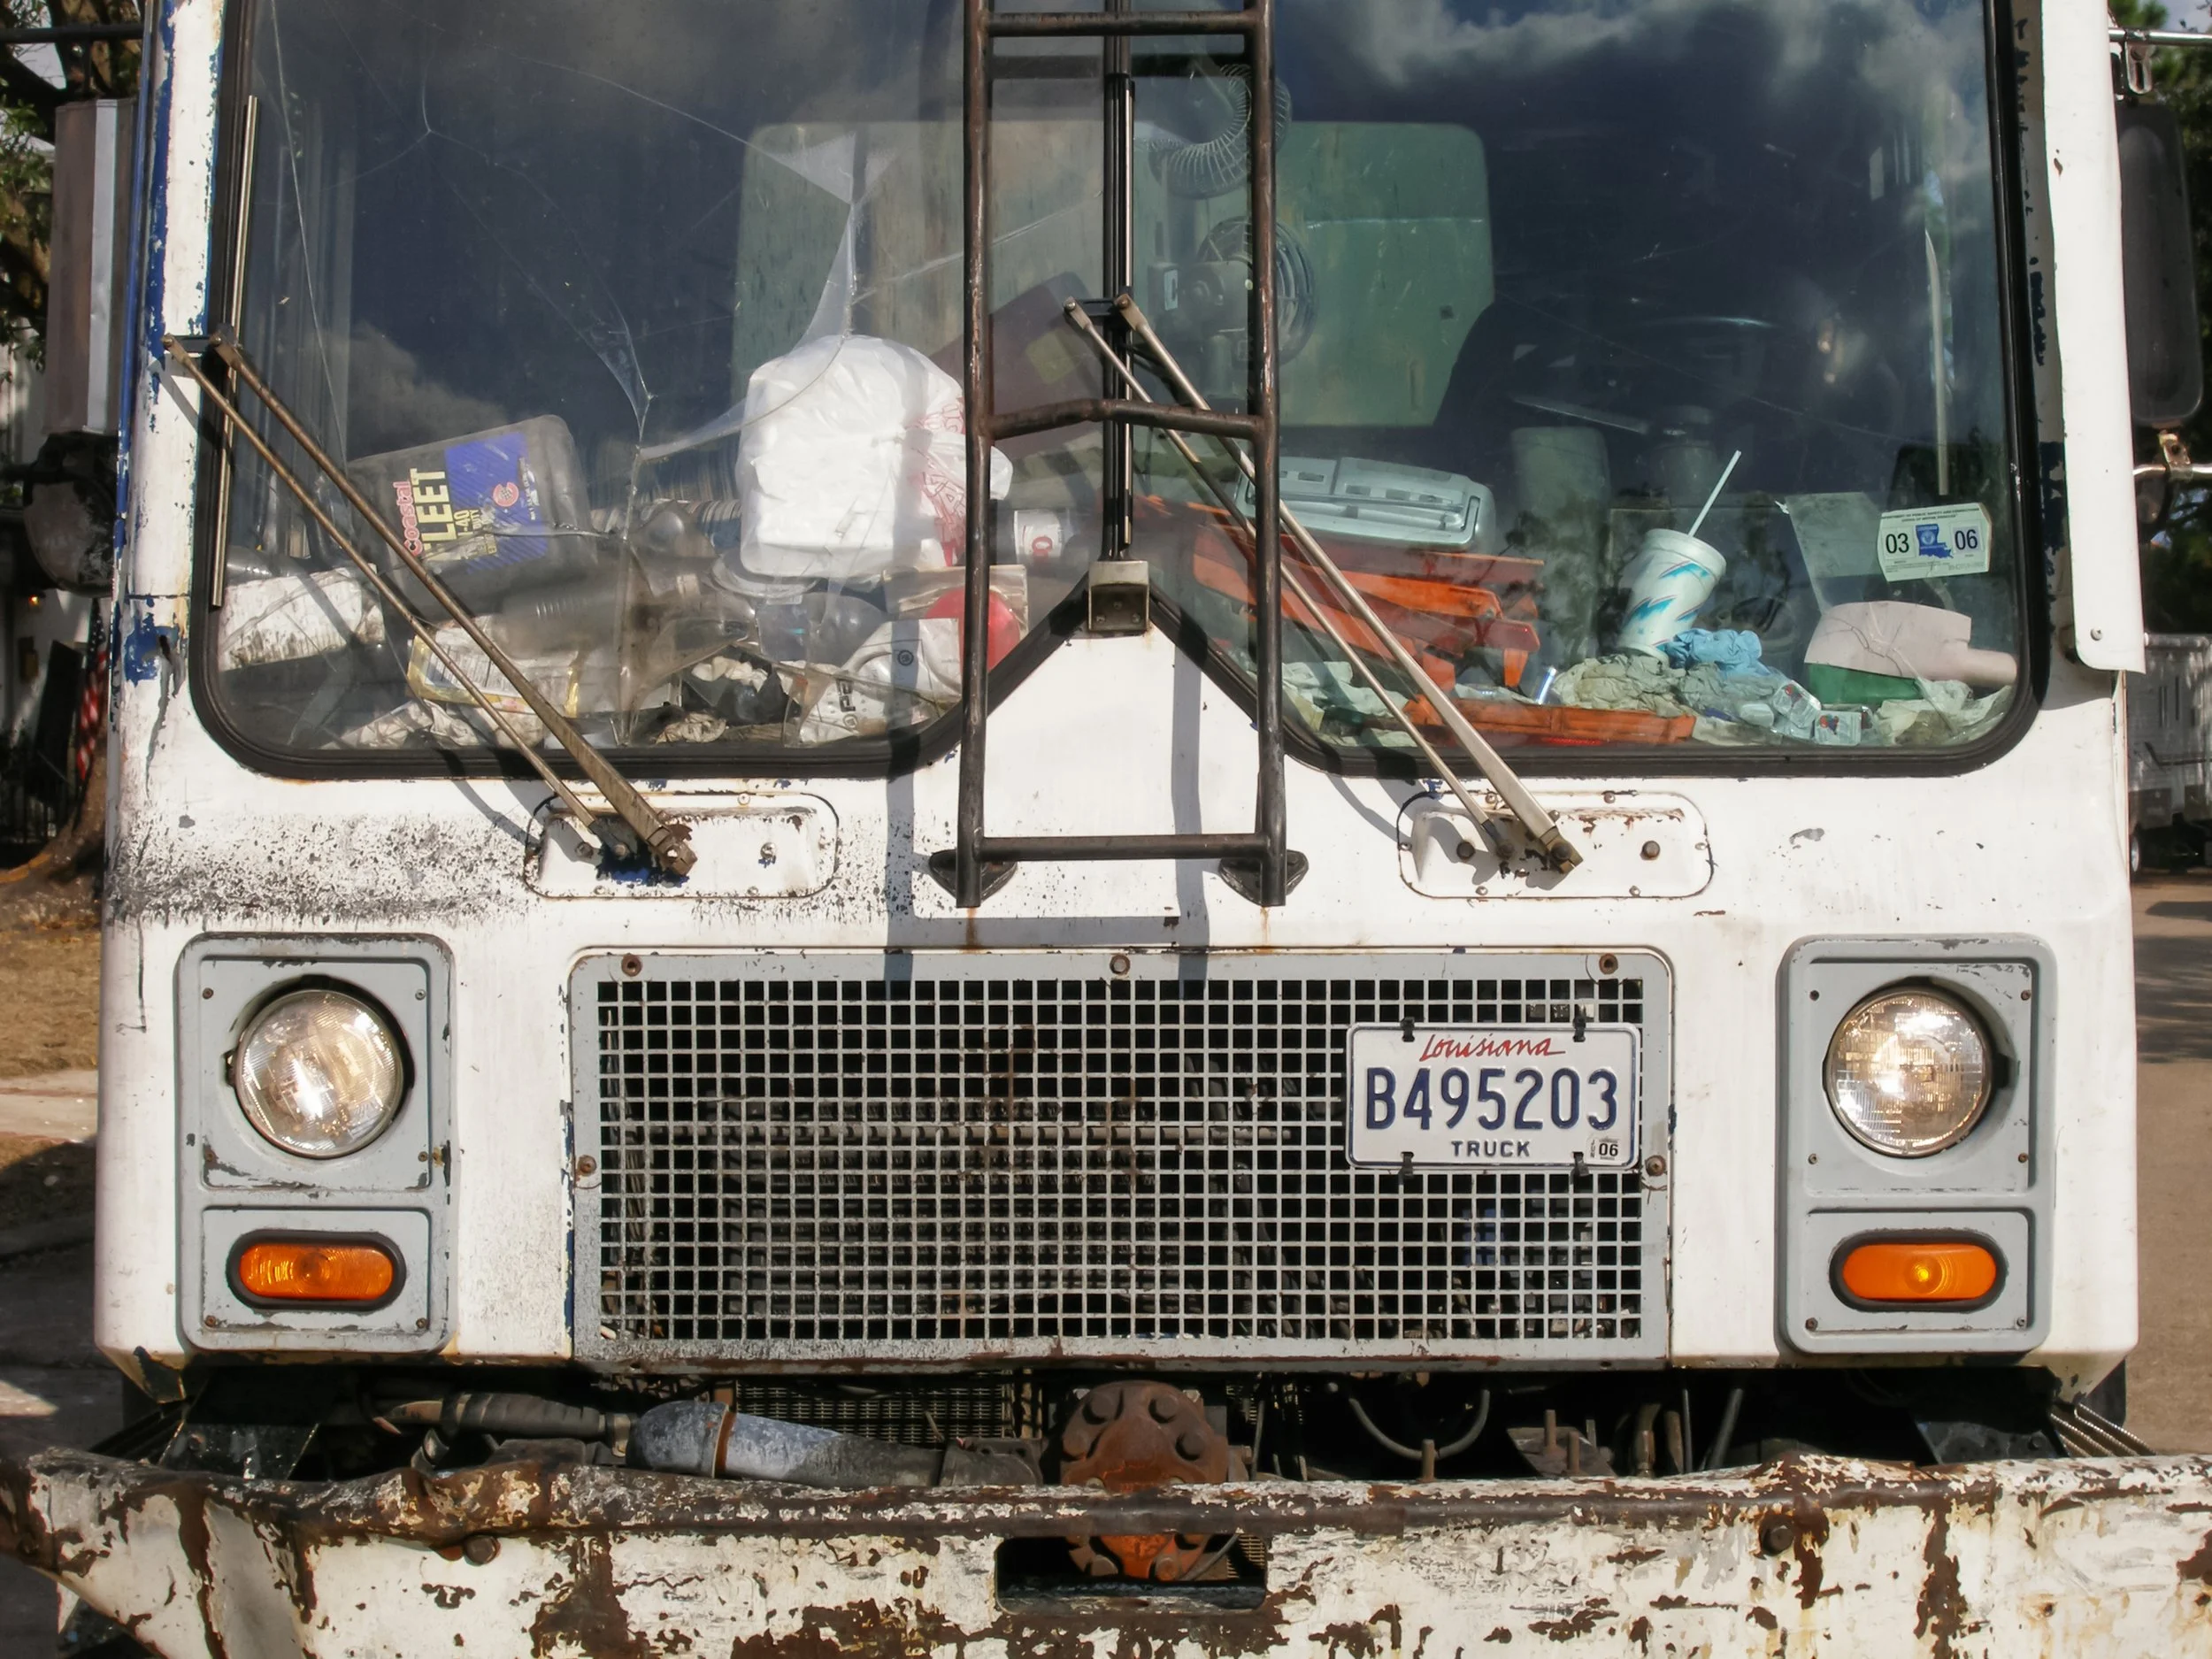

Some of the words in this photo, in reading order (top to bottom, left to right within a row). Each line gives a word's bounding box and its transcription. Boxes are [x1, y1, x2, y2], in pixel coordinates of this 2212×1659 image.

[393, 480, 424, 557] Coastal
[1886, 533, 1909, 554] 03
[1955, 529, 1978, 550] 06
[1419, 1033, 1566, 1062] Louisiana
[1366, 1067, 1618, 1131] B495203
[1450, 1141, 1532, 1157] TRUCK
[1599, 1142, 1618, 1156] 06
